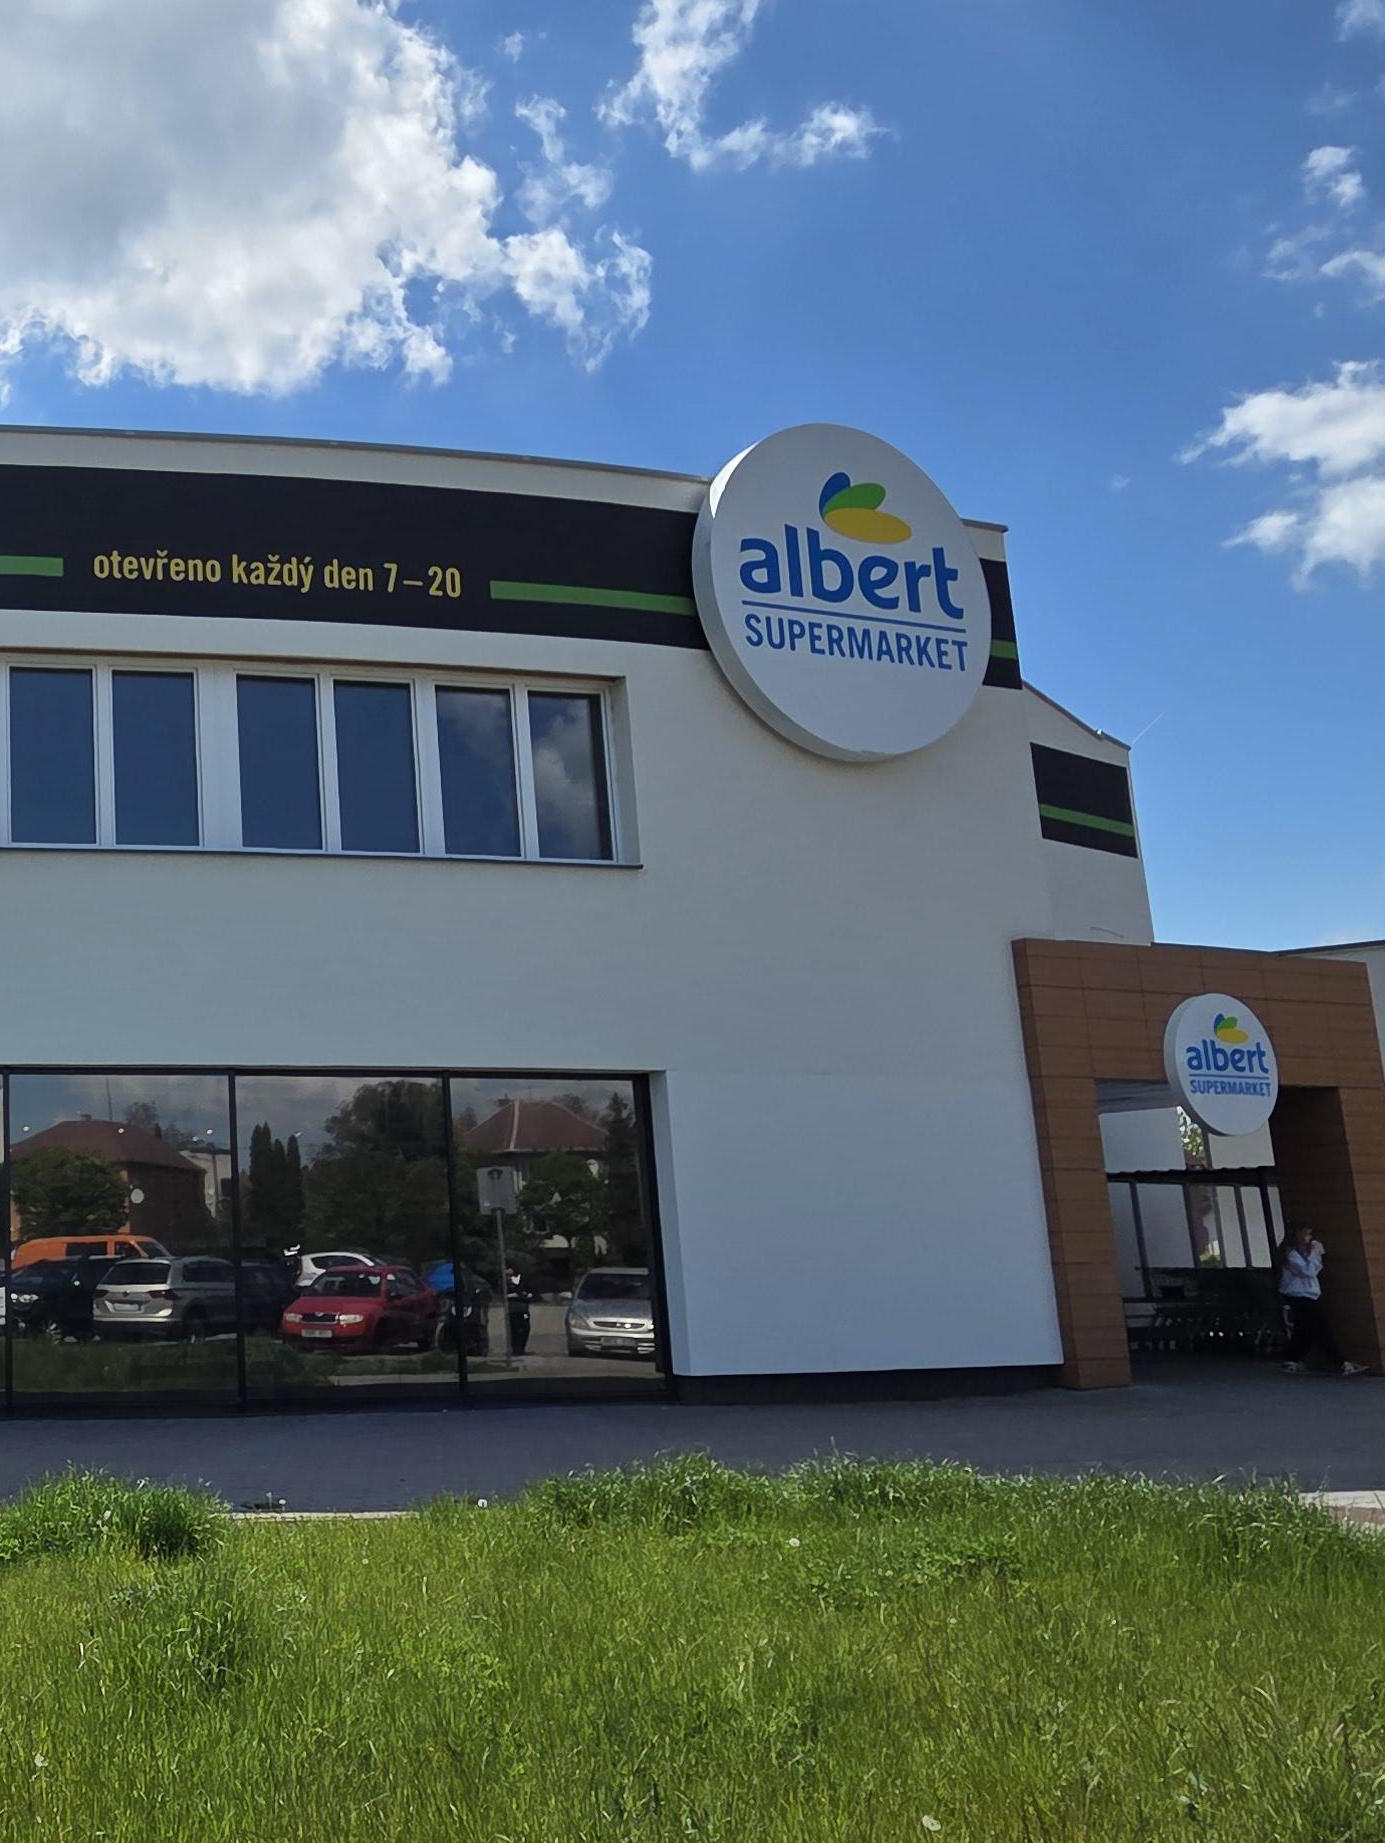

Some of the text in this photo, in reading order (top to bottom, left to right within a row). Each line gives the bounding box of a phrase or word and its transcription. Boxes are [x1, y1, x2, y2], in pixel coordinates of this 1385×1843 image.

[93, 549, 222, 583] otevřeno
[231, 553, 314, 594] každý
[323, 558, 374, 592] den
[739, 524, 964, 619] albert
[745, 613, 968, 672] SUPERMARKET
[1185, 1039, 1269, 1074] albert
[1190, 1079, 1271, 1097] SUPERMARKET
